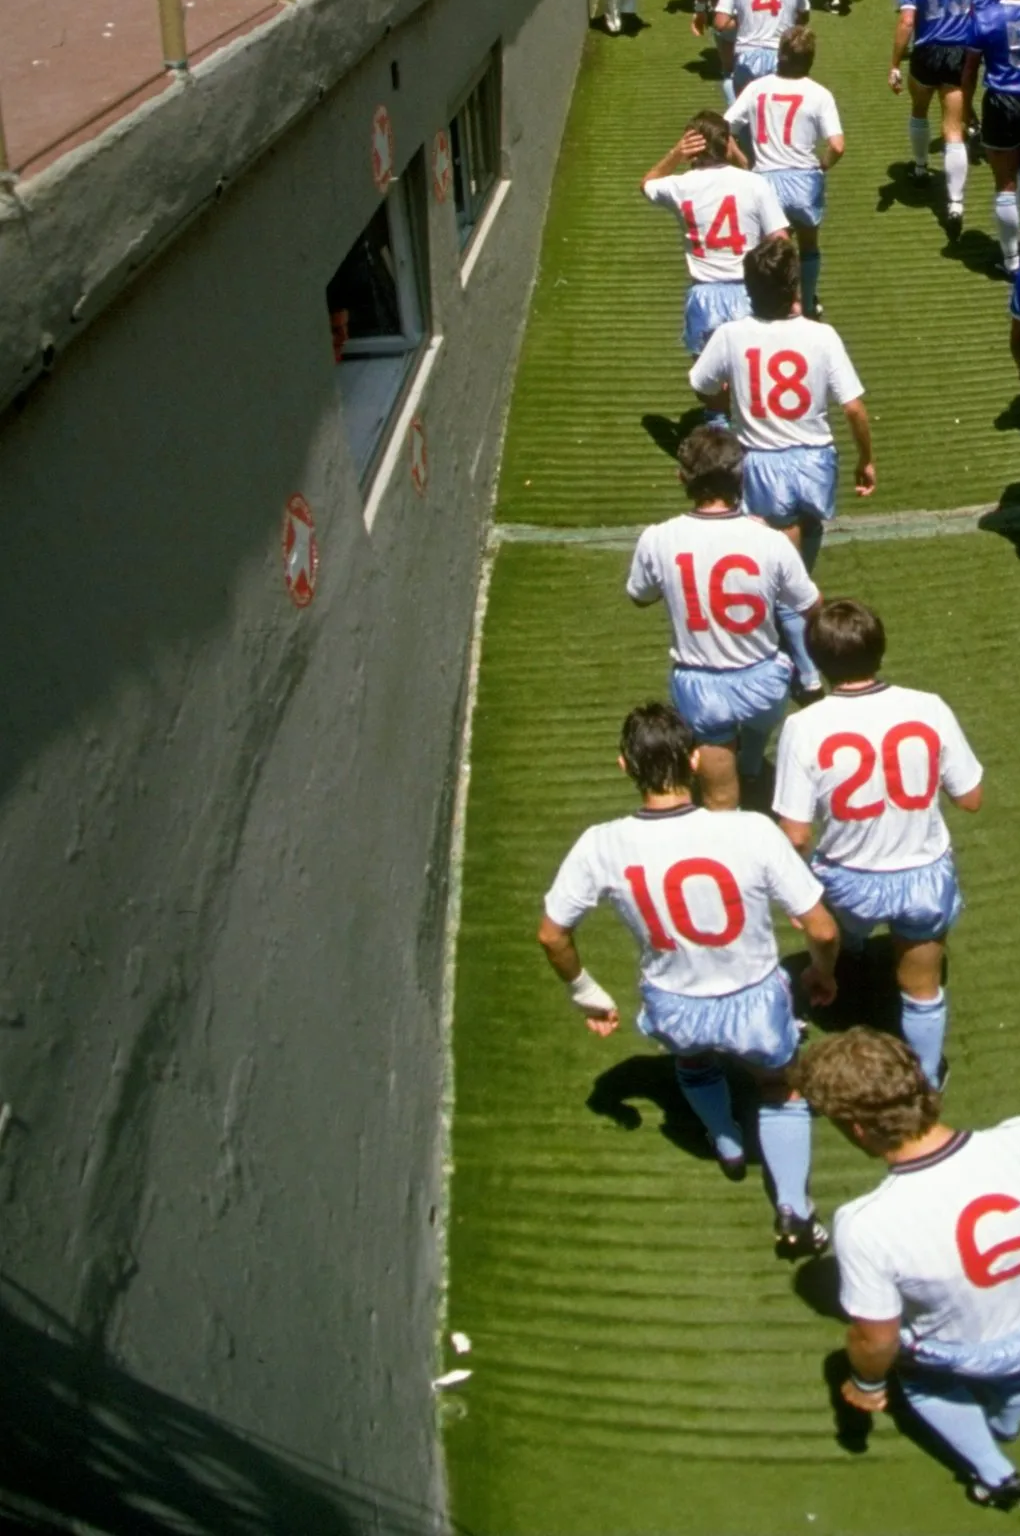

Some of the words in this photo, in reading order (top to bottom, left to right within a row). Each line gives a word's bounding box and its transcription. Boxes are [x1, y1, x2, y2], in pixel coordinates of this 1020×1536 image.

[756, 92, 804, 146] 17
[680, 194, 747, 259] 14
[745, 347, 812, 421] 18
[675, 551, 767, 635] 16
[817, 720, 942, 823] 20
[624, 857, 746, 952] 10
